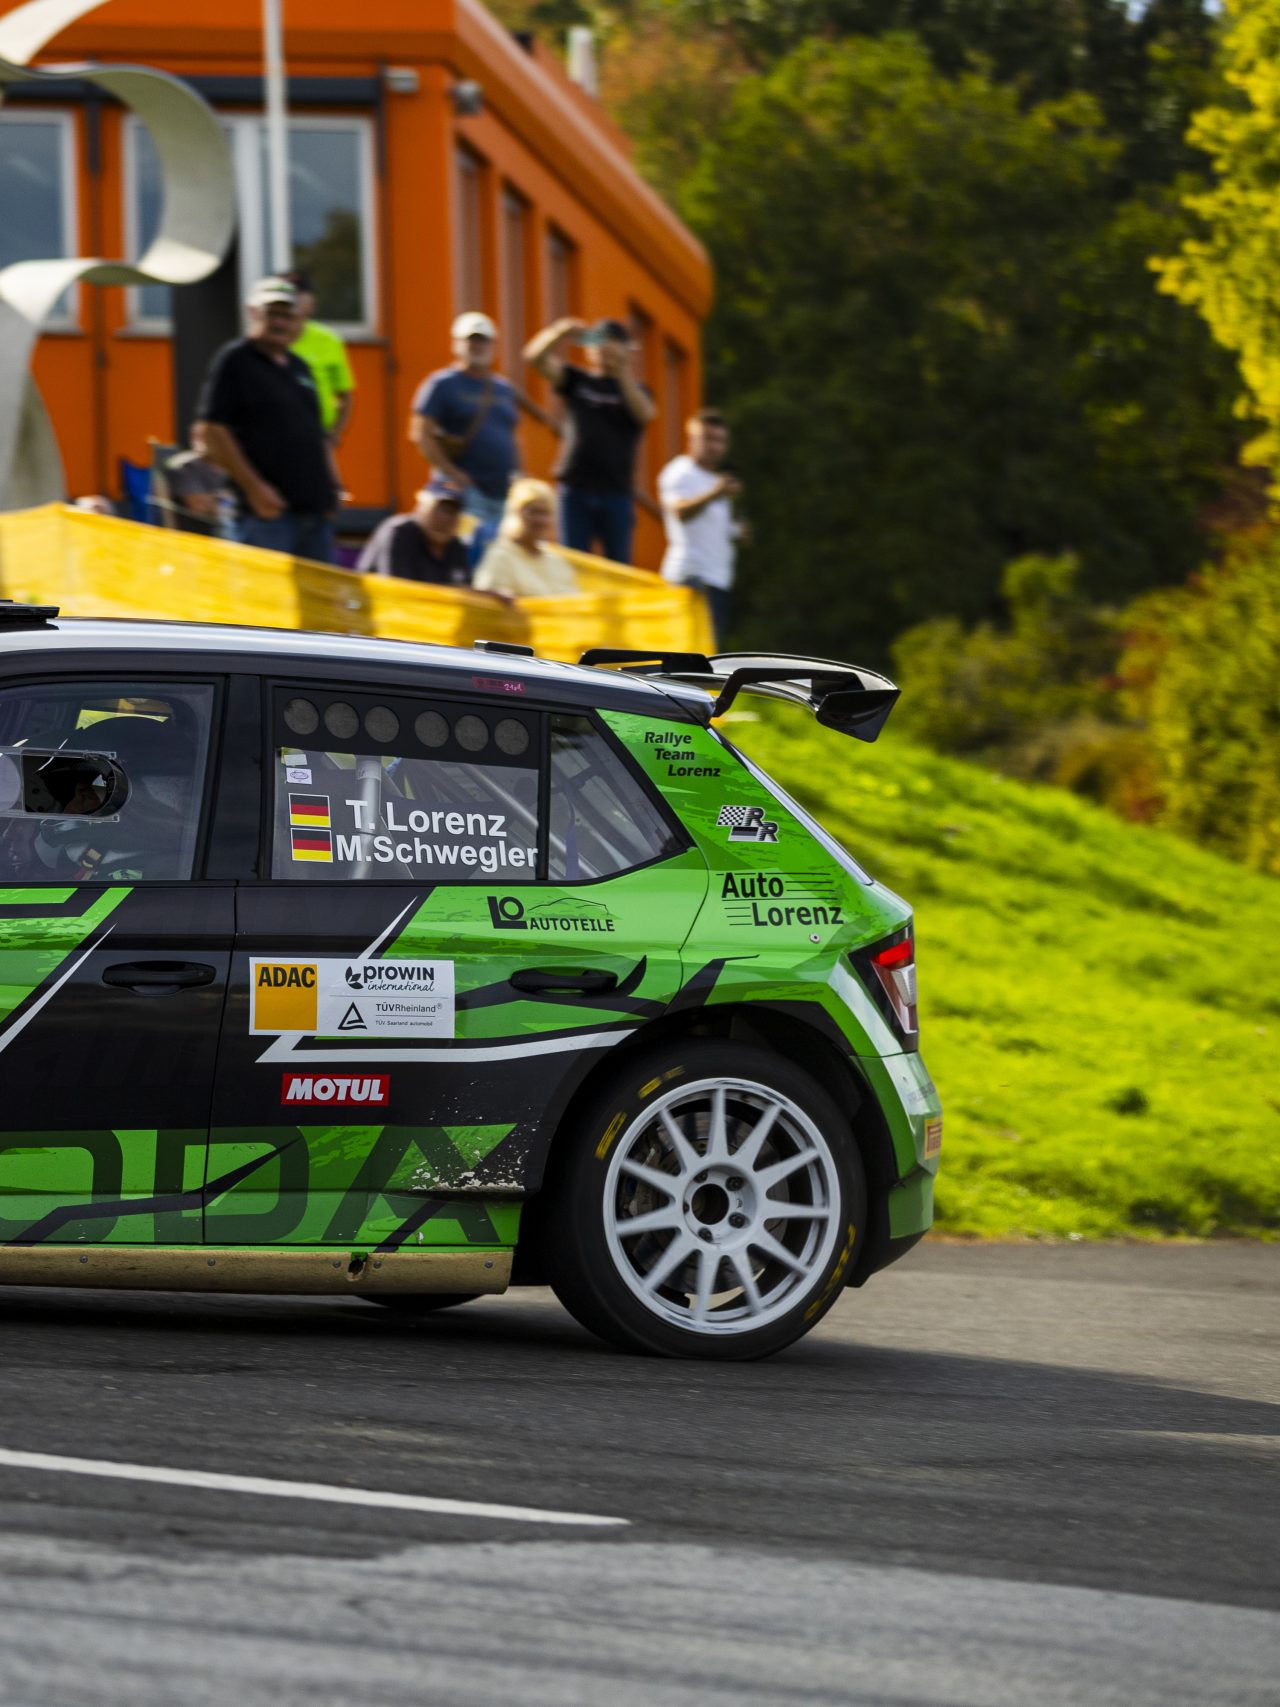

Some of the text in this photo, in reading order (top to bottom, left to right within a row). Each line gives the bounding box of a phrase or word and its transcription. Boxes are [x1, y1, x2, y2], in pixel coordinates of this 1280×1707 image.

[644, 731, 692, 746] Rallye
[654, 748, 695, 761] Team
[667, 764, 721, 777] Lorenz
[345, 799, 507, 837] T. Lorenz
[335, 834, 539, 873] M.Schwegler
[721, 872, 784, 899] Auto
[530, 917, 616, 932] AUTOTEILE
[752, 902, 844, 926] Lorenz
[258, 966, 315, 988] ADAC
[368, 979, 435, 992] international
[285, 1078, 384, 1101] MOTUL
